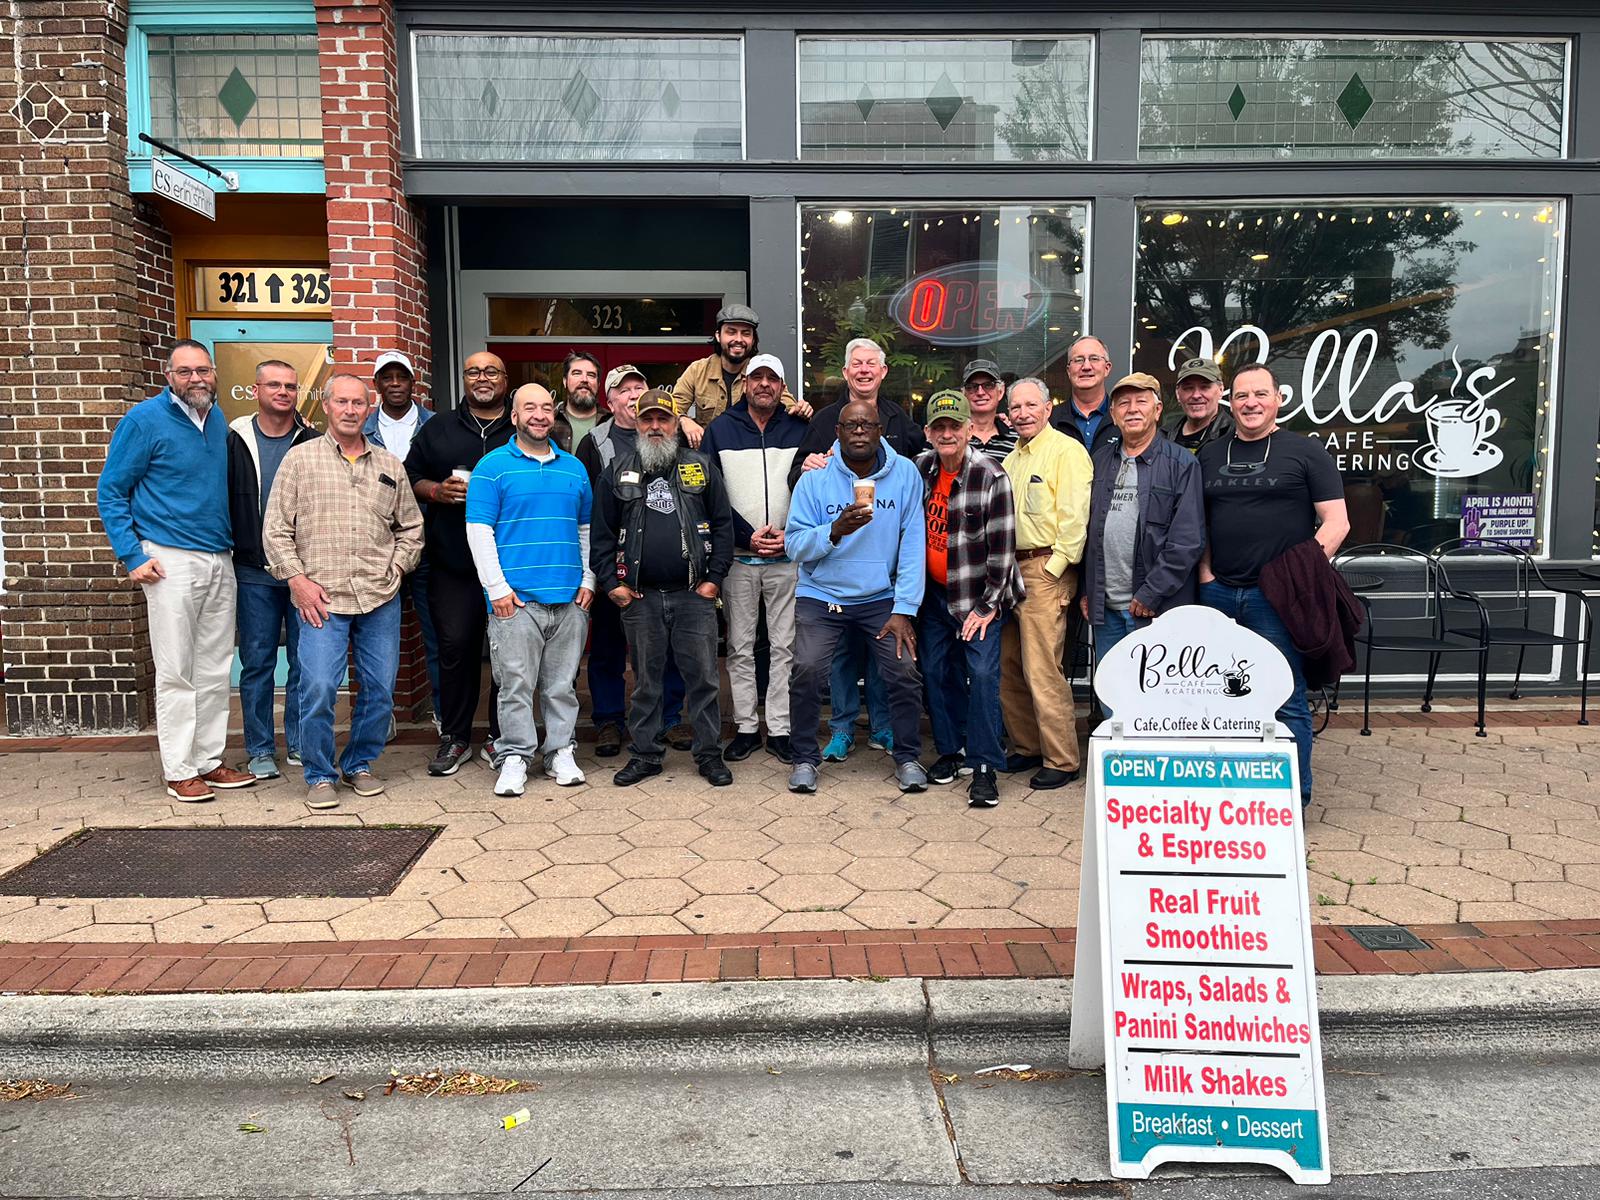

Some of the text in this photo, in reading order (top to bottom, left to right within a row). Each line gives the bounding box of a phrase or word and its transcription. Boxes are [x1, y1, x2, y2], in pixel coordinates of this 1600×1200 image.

[155, 168, 171, 193] es
[219, 272, 331, 304] 321 325
[592, 305, 623, 329] 323
[908, 279, 1032, 332] OPEN
[1329, 453, 1410, 471] ERING
[826, 499, 896, 515] CANA
[1466, 496, 1533, 507] APRIL IS MONTH
[1491, 520, 1529, 528] PURPLE UP!
[1131, 643, 1255, 693] Bella's
[1200, 717, 1210, 731] &
[1213, 717, 1261, 733] Catering
[1110, 756, 1284, 781] OPEN 7 DAYS A WEEK
[1106, 798, 1293, 831] Specialty Coffee
[1138, 832, 1266, 864] & Espresso
[1149, 887, 1261, 916] Real Fruit
[1146, 922, 1268, 951] Smoothies
[1121, 972, 1291, 1007] Wraps, Salads &
[1115, 1010, 1311, 1045] Panini Sandwiches
[1144, 1064, 1288, 1097] Milk Shakes
[1132, 1110, 1304, 1139] Breakfast Dessert
